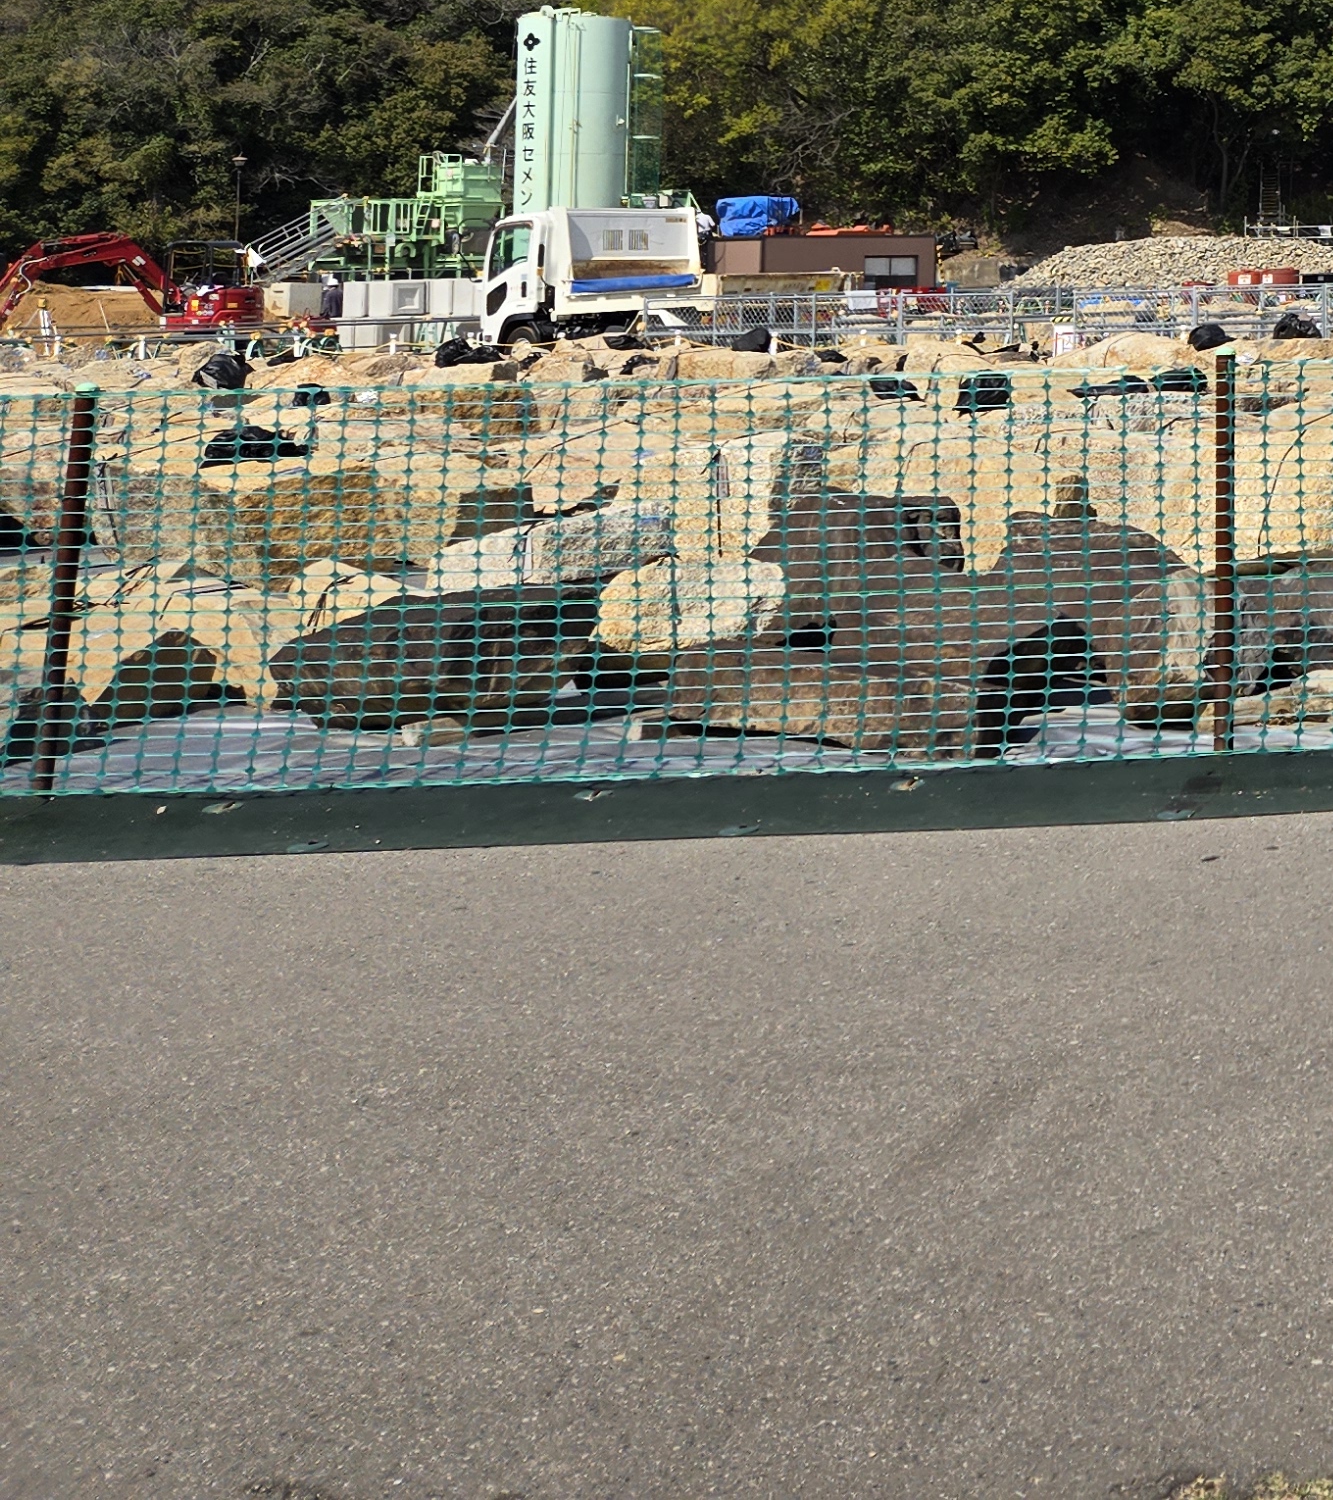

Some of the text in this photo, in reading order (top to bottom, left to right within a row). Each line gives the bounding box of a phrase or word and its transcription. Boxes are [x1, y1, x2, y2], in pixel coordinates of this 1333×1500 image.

[521, 57, 538, 214] 住友大阪セメン
